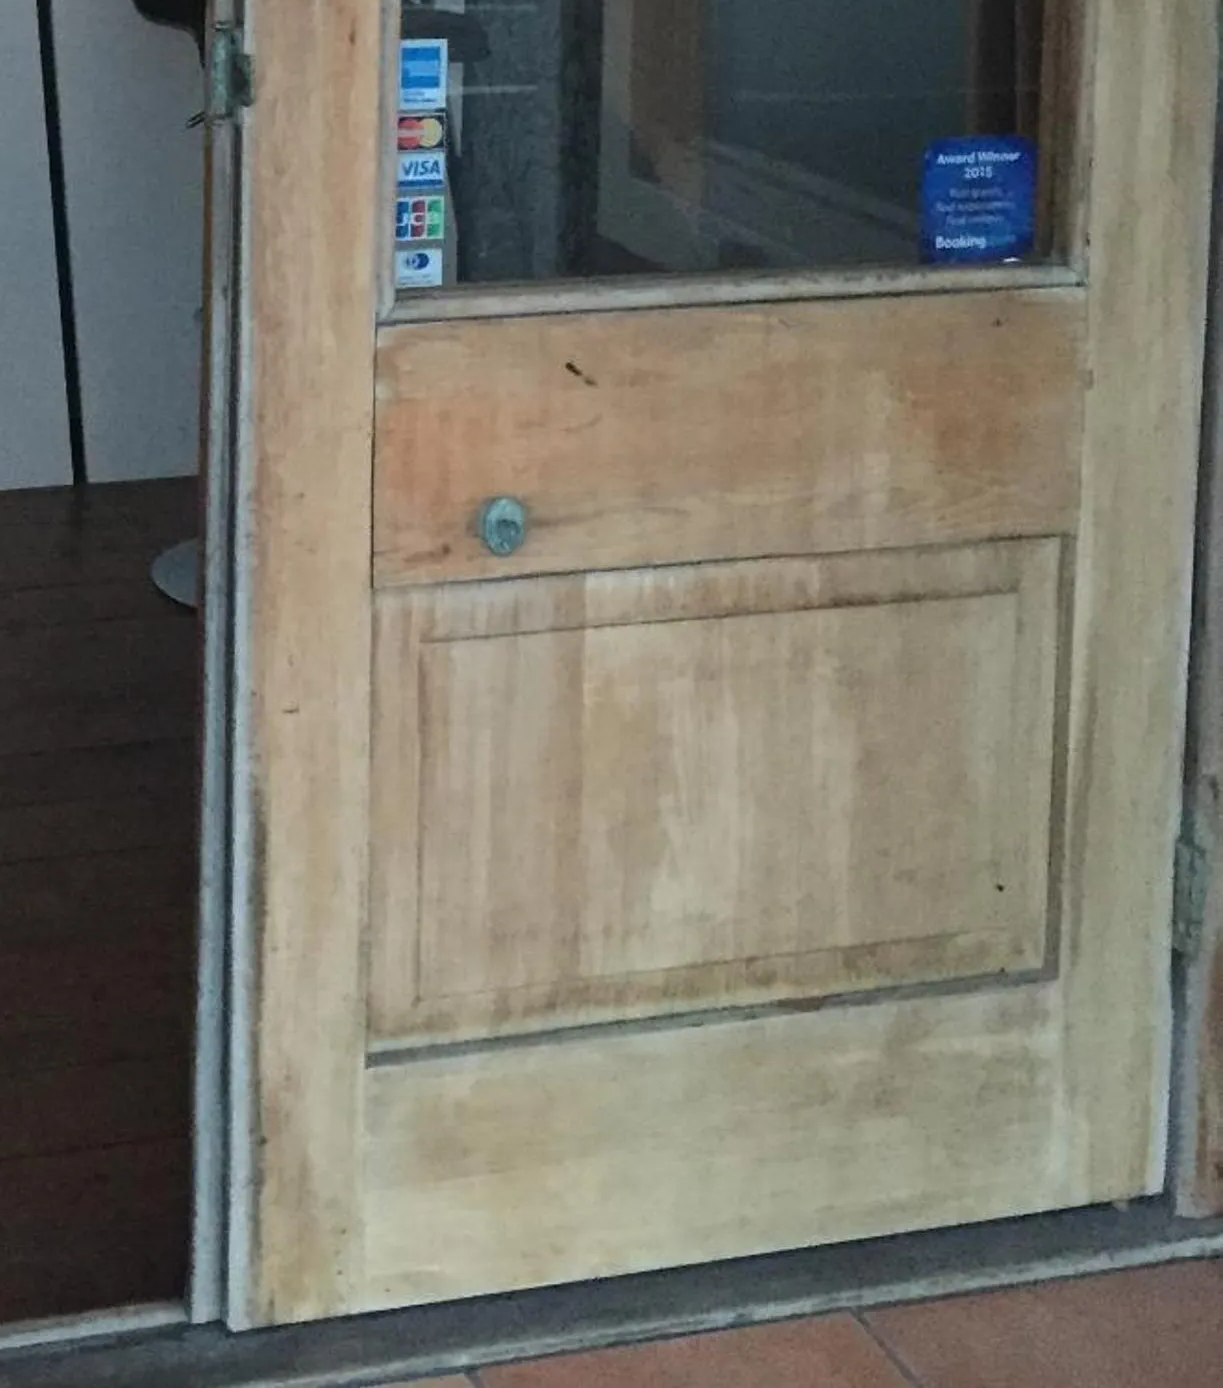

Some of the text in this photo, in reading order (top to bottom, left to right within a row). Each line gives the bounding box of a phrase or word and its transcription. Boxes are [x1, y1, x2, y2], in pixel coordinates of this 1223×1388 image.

[936, 151, 1022, 164] Award Winner
[402, 160, 441, 176] VISA
